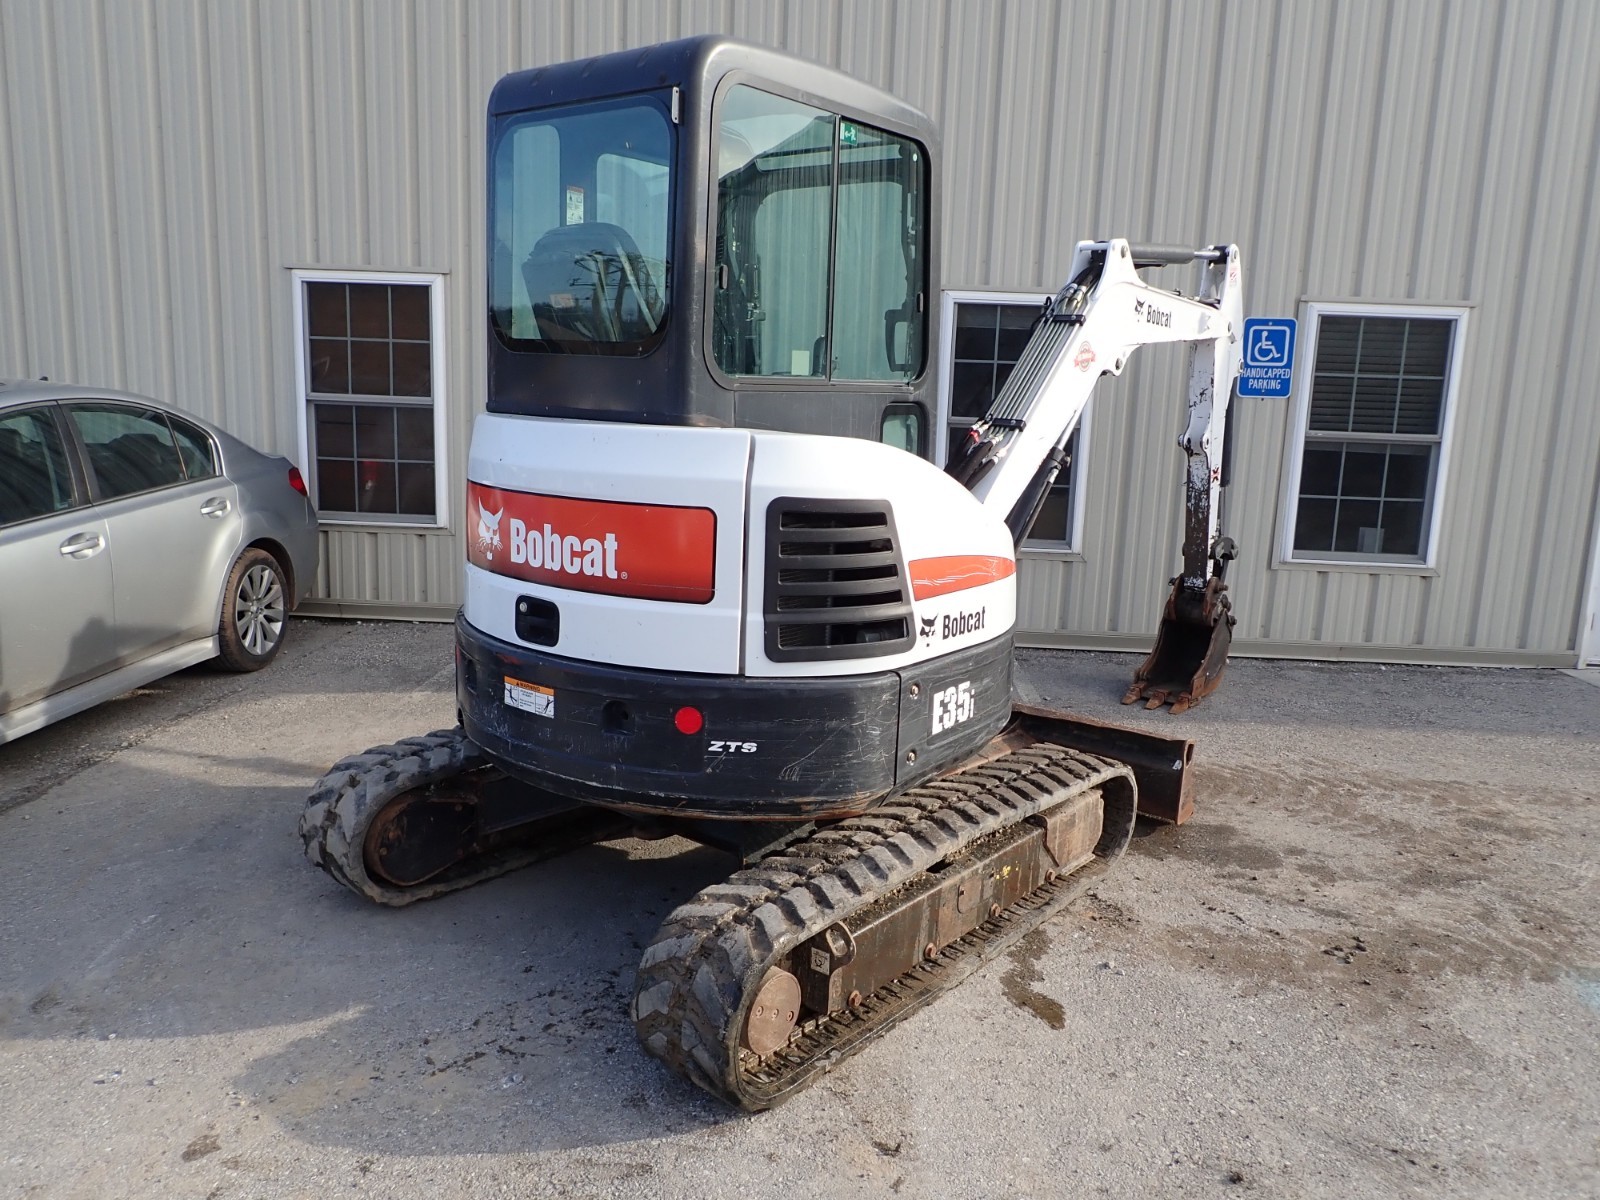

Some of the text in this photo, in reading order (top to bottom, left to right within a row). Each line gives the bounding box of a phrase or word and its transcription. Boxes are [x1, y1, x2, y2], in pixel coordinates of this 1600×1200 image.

[1146, 304, 1172, 328] Bobcat
[1241, 367, 1291, 379] HANDICAPPED
[1248, 379, 1281, 390] PARKING
[510, 518, 618, 579] Bobcat
[942, 606, 985, 639] Bobcat
[520, 681, 541, 692] WARNING
[932, 681, 975, 734] E35i
[708, 741, 758, 753] ZTS
